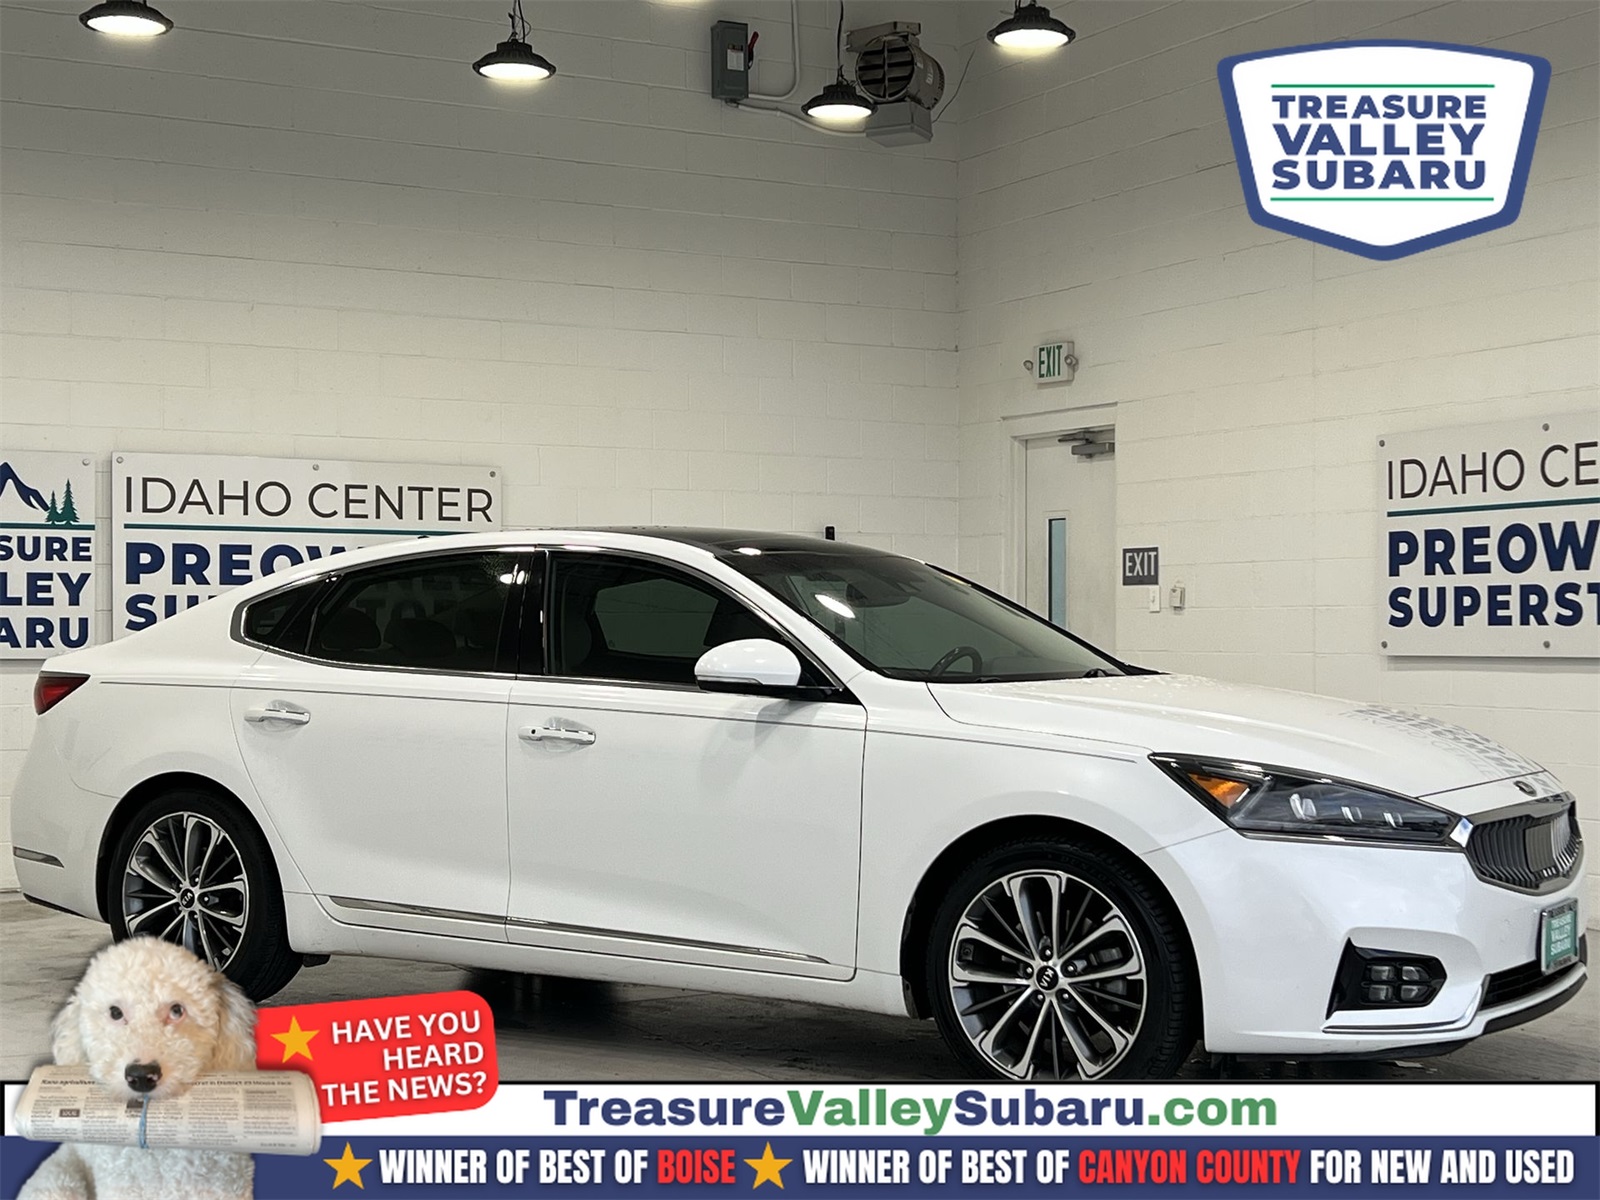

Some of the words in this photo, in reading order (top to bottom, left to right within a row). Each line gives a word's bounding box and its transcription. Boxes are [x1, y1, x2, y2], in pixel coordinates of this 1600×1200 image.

[1039, 345, 1062, 378] EXIT
[1387, 448, 1525, 500] IDAHO
[1540, 441, 1599, 488] CE
[125, 476, 292, 517] IDAHO
[308, 482, 493, 523] CENTER
[0, 535, 92, 562] SURE
[1124, 552, 1157, 577] EXIT
[1039, 967, 1055, 988] KIA
